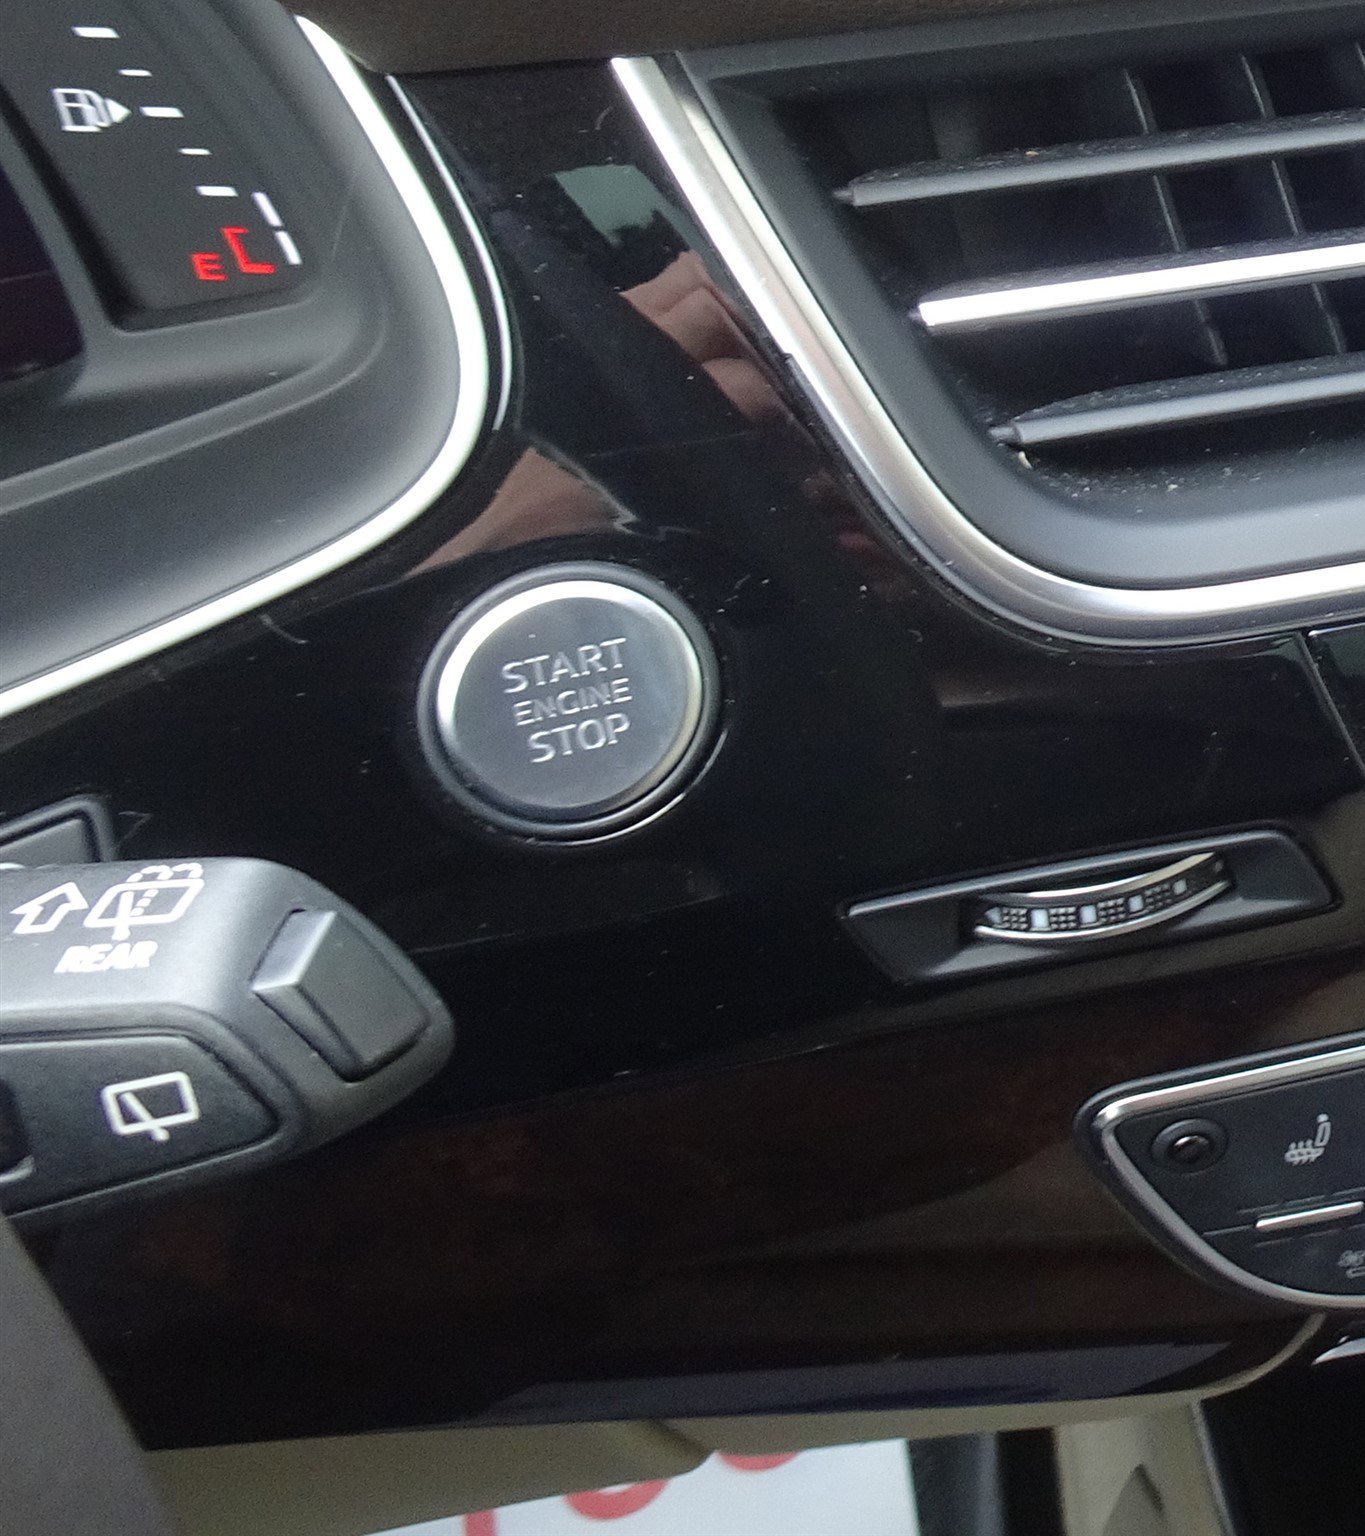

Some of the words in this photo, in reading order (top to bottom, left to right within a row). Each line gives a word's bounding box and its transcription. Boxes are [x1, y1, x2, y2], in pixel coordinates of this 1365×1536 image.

[501, 636, 628, 694] START
[512, 676, 633, 726] ENGINE
[527, 712, 631, 764] STOP
[53, 941, 158, 973] REAR
